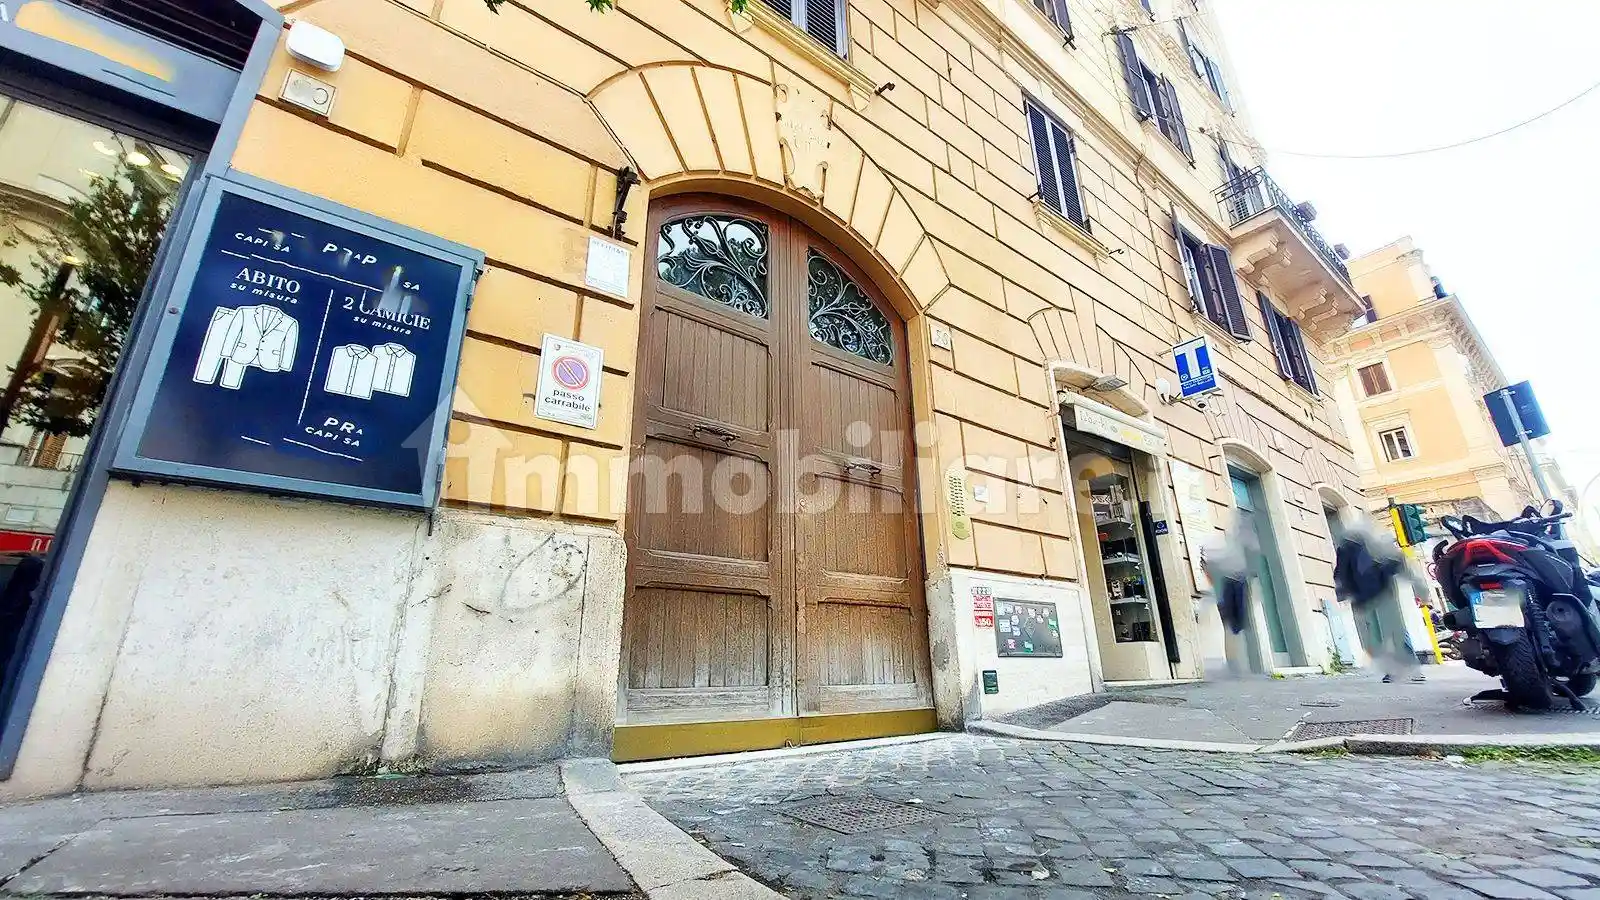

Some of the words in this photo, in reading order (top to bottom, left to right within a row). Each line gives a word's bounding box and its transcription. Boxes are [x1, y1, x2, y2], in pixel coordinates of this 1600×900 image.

[235, 232, 268, 247] CAPI
[273, 244, 290, 253] SA
[235, 267, 300, 294] ABITO
[229, 282, 246, 291] su
[252, 288, 298, 304] misura
[342, 296, 354, 310] 2
[353, 316, 367, 324] su
[371, 320, 412, 335] misura
[544, 395, 591, 412] carrabile
[552, 388, 585, 402] passo
[305, 426, 338, 441] CAPI
[343, 437, 360, 447] SA
